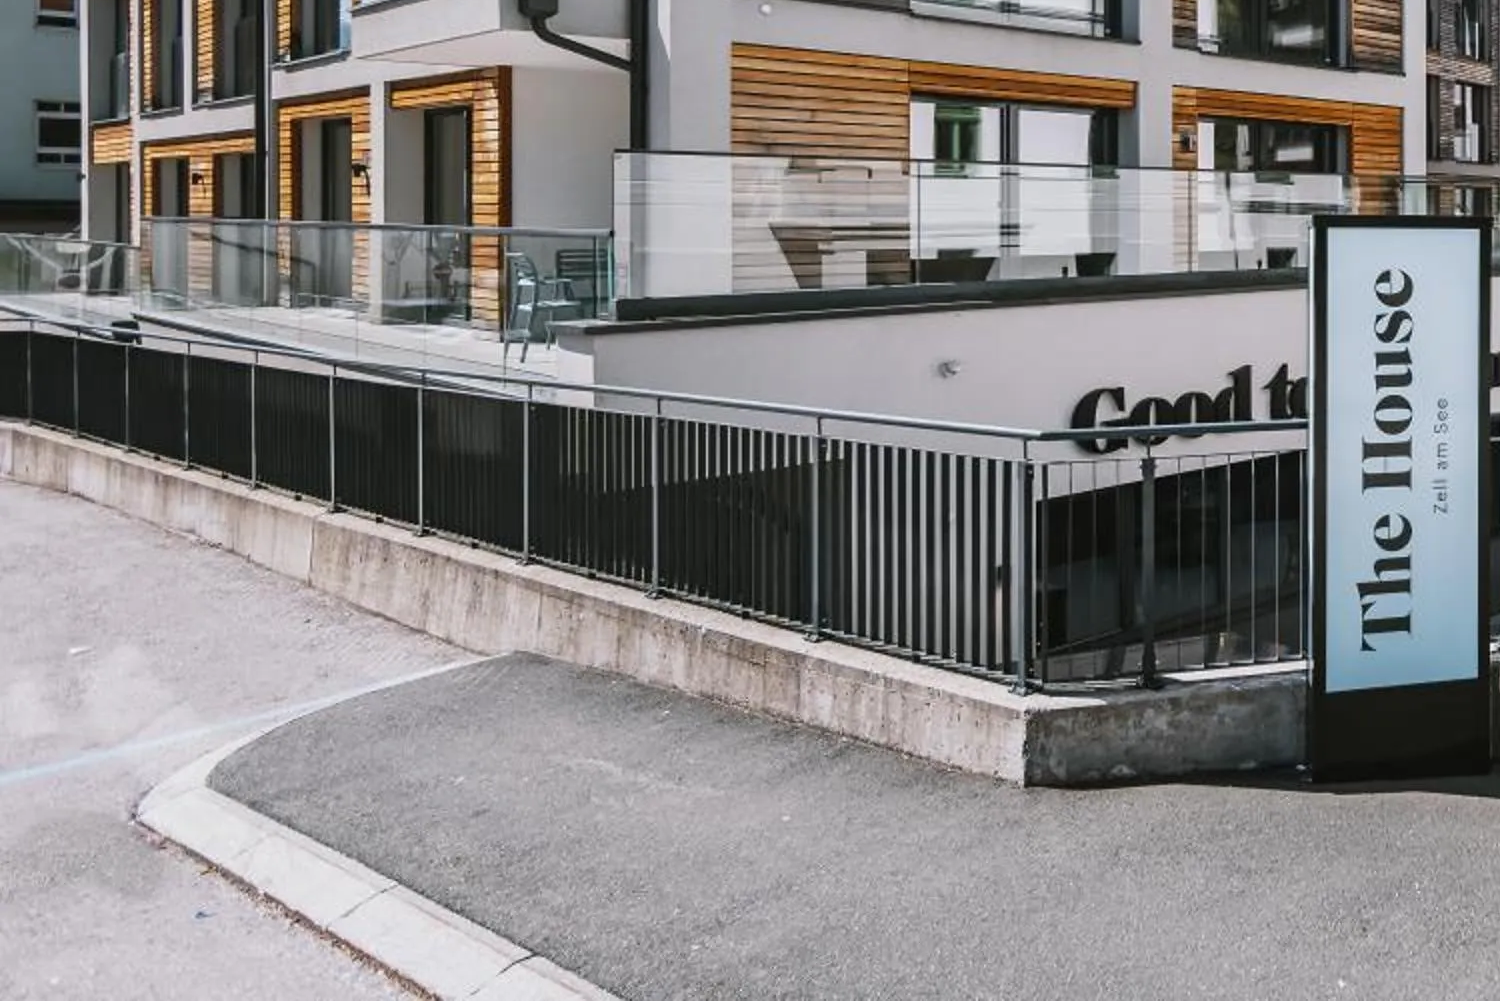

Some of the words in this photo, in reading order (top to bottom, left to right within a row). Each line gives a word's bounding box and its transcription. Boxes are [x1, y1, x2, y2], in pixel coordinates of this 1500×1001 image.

[1070, 364, 1252, 455] Good
[1362, 268, 1414, 495] House
[1433, 398, 1449, 434] See
[1437, 442, 1449, 470] am
[1432, 479, 1448, 514] Zell
[1356, 513, 1413, 651] The
